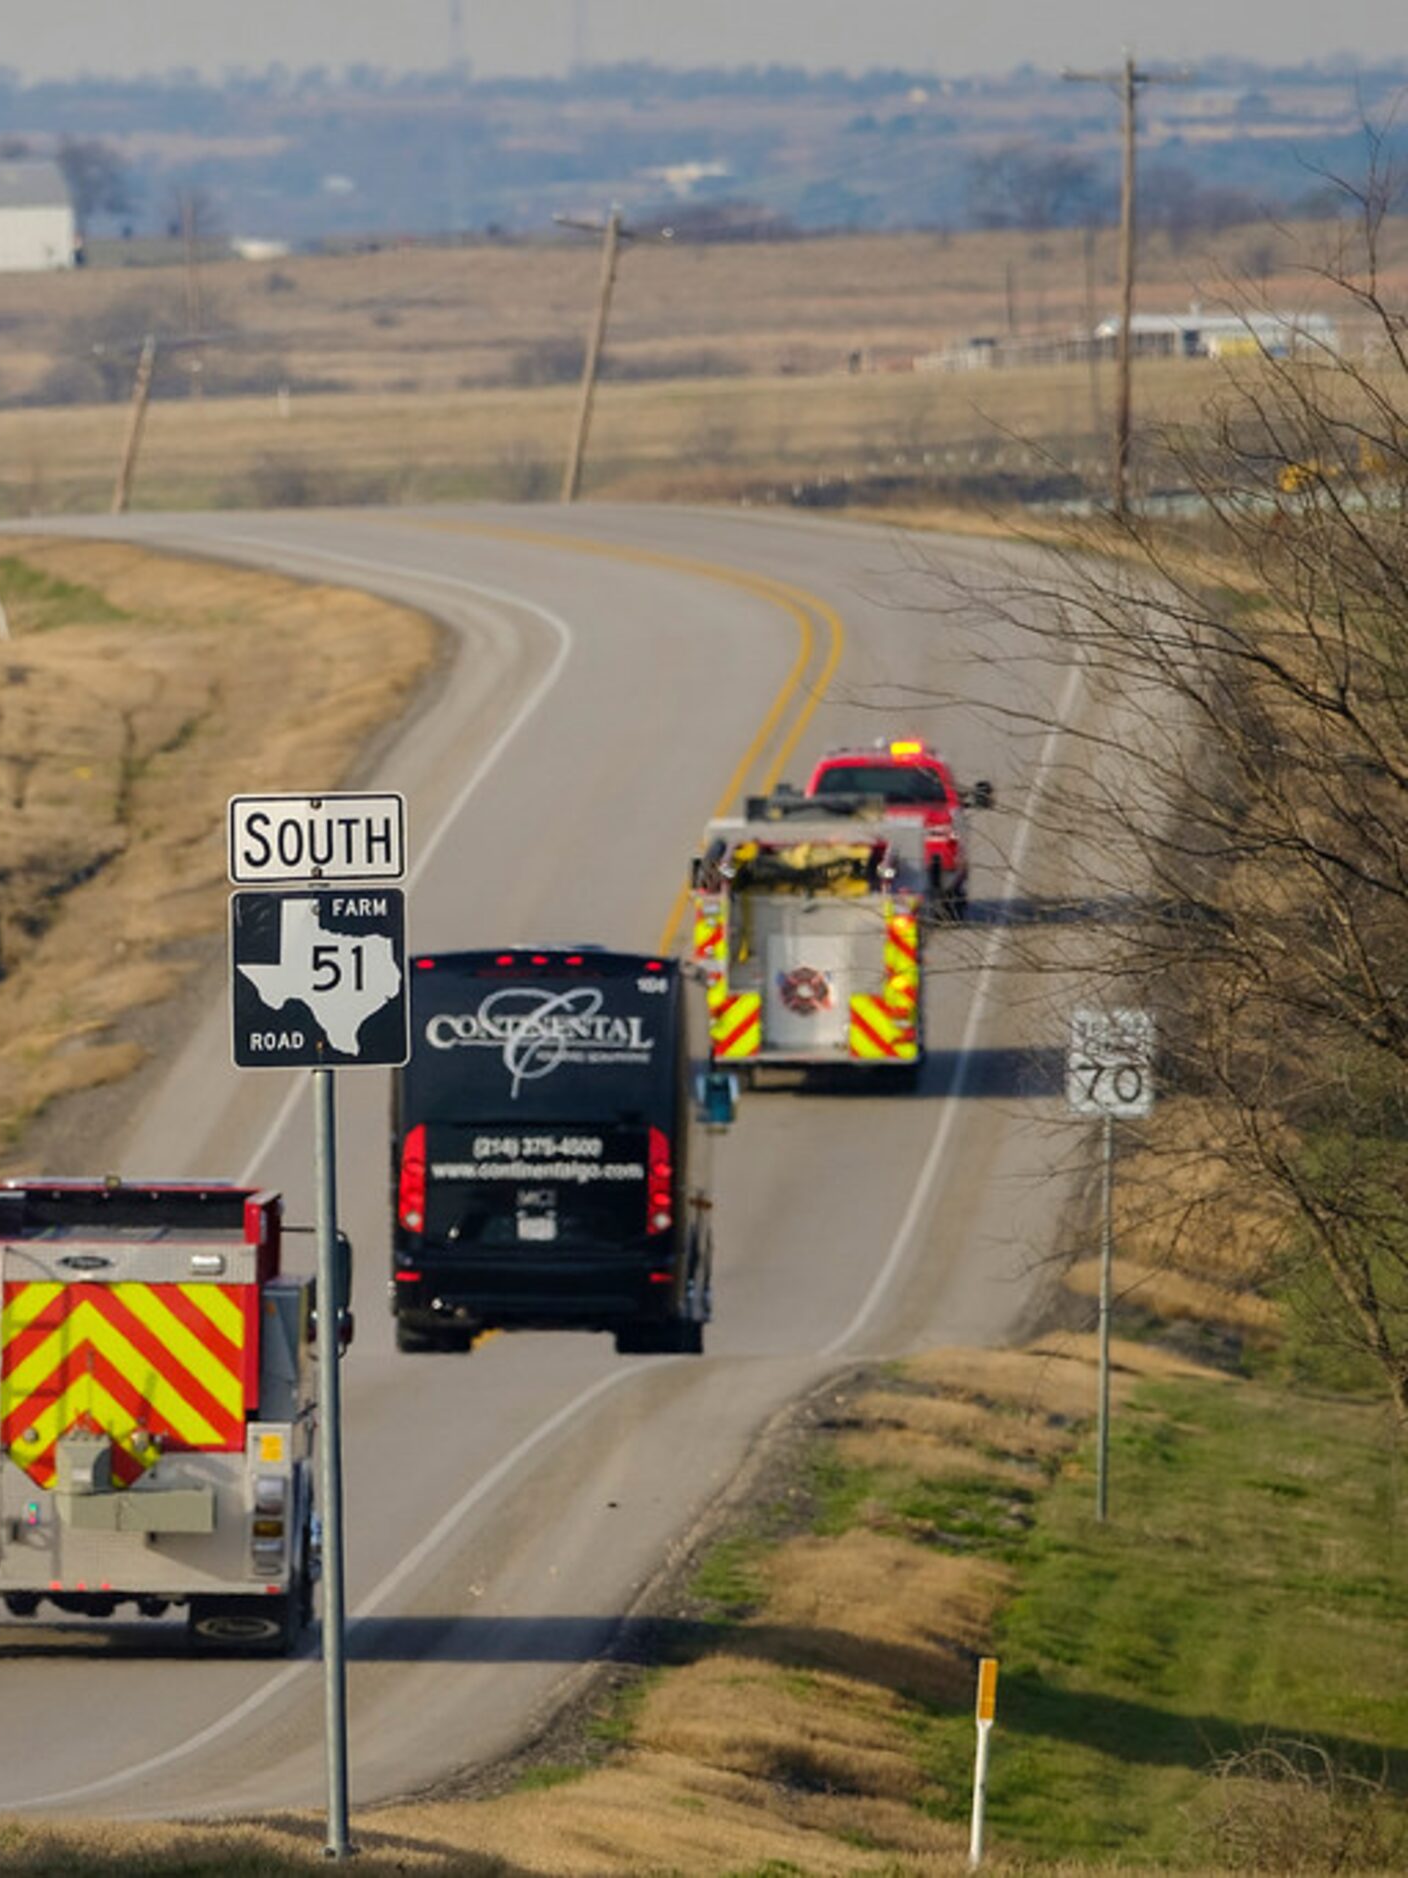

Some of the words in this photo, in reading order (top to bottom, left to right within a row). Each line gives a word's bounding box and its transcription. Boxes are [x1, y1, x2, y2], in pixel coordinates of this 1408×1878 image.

[243, 812, 392, 868] SOUTH
[332, 898, 387, 917] FARM
[311, 945, 364, 992] 51
[250, 1032, 305, 1051] ROAD
[1075, 1064, 1142, 1102] 70
